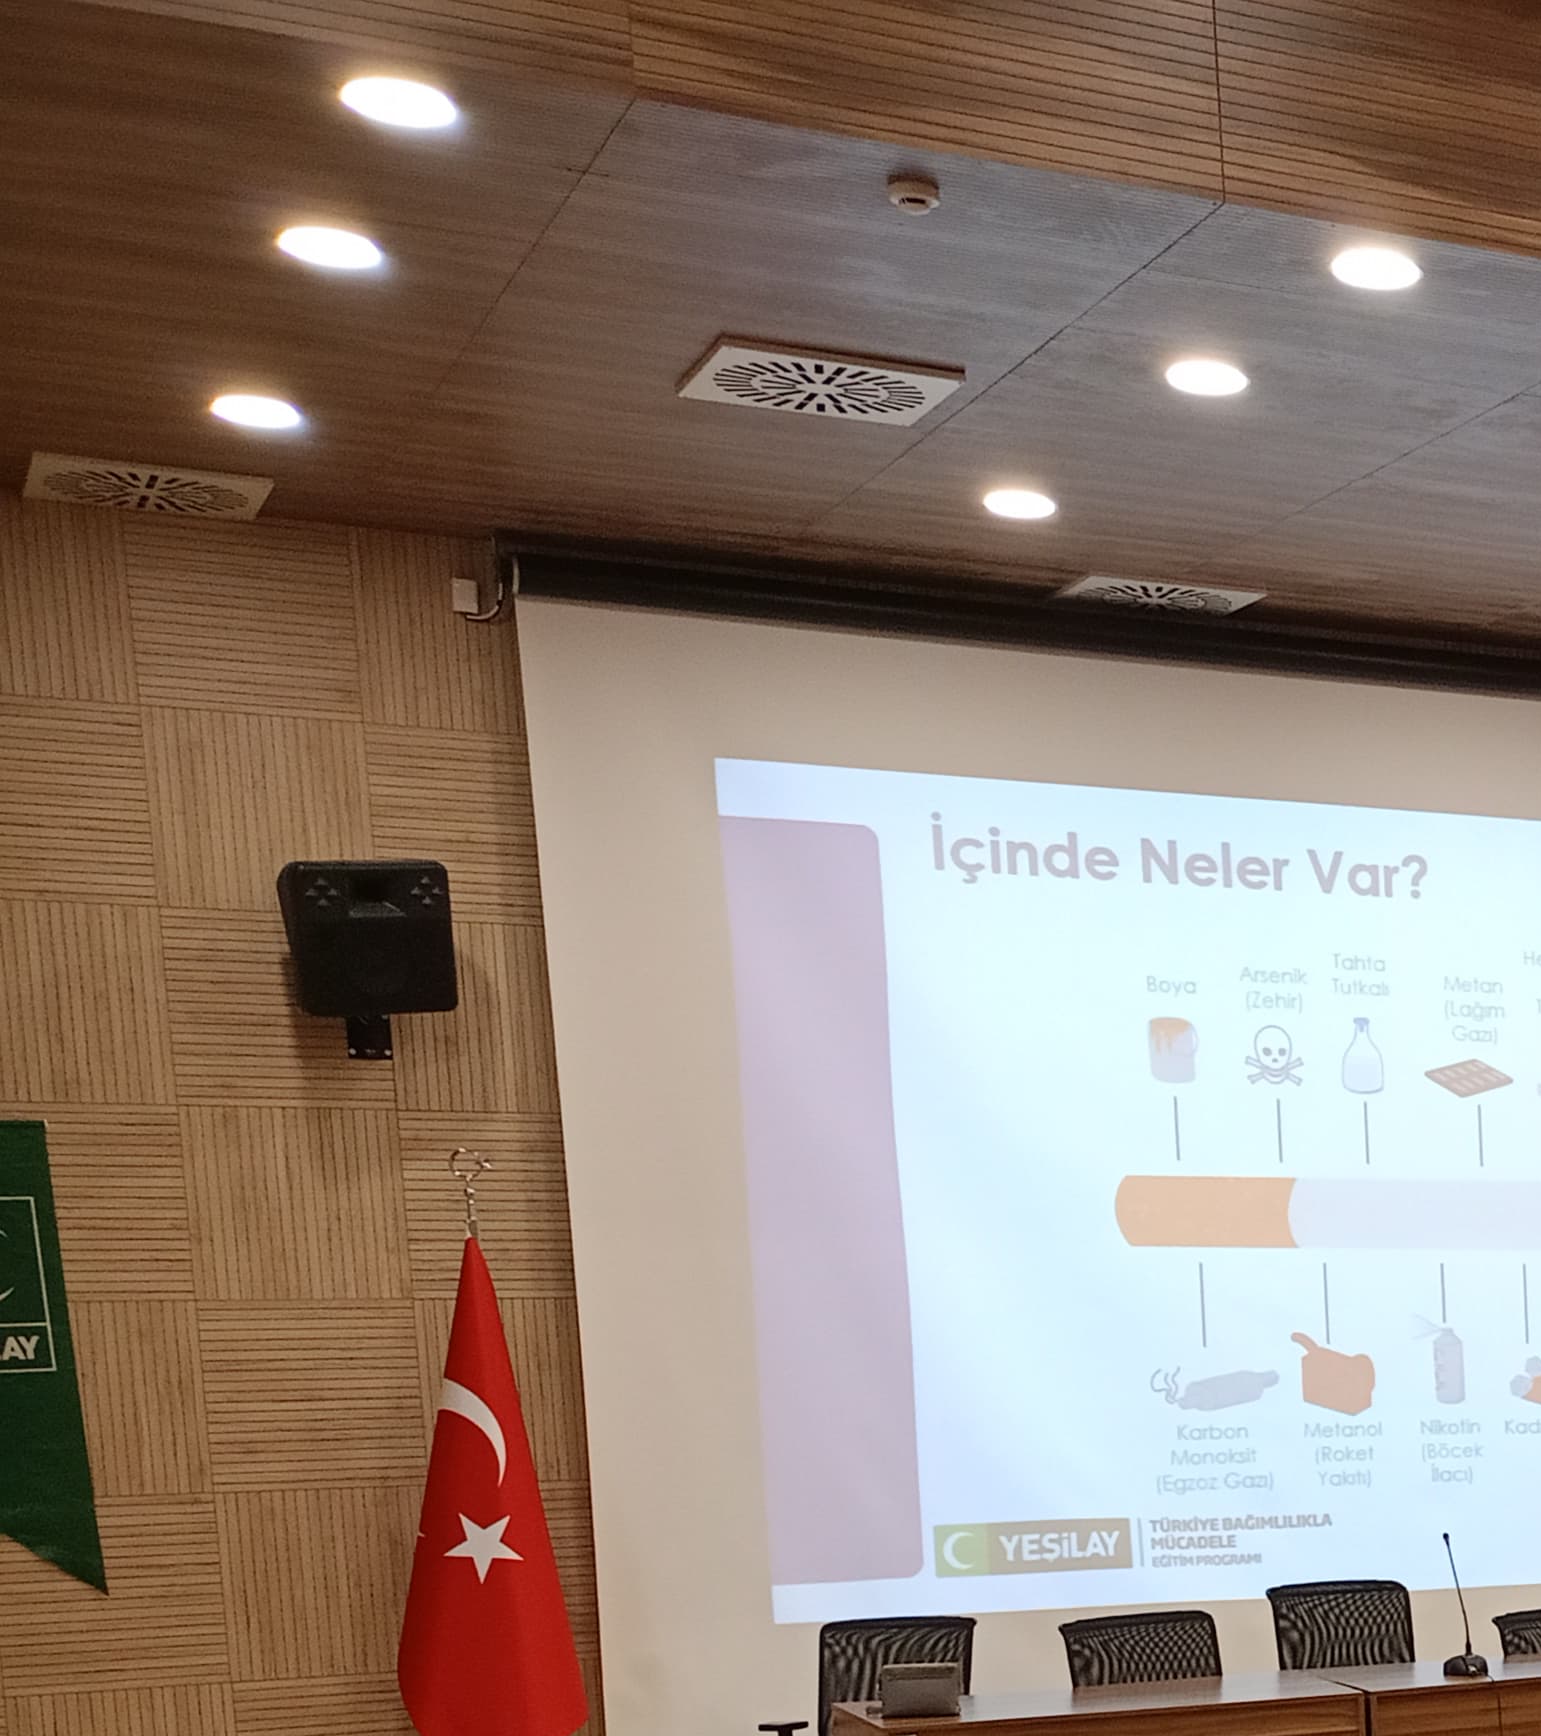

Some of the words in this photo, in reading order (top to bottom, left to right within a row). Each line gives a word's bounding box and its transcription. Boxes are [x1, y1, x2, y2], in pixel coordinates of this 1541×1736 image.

[929, 811, 1120, 884] İçinde
[1140, 838, 1290, 891] Neler
[1306, 848, 1429, 900] Var?
[1331, 953, 1386, 972] Tahta
[1239, 966, 1308, 985] Arsenik
[1443, 975, 1504, 994] Metan
[1146, 975, 1197, 997] Boya
[1245, 991, 1303, 1014] (Zehir)
[1176, 1424, 1249, 1441] Karbon
[1303, 1421, 1383, 1439] Metanol
[1420, 1419, 1481, 1436] Nikotin
[1170, 1448, 1257, 1466] Monoksit
[1315, 1446, 1375, 1465] (Roket
[1156, 1474, 1218, 1496] (Egzoz
[1149, 1515, 1220, 1533] TÜRKİYE
[1151, 1535, 1237, 1550] MÜCADELE
